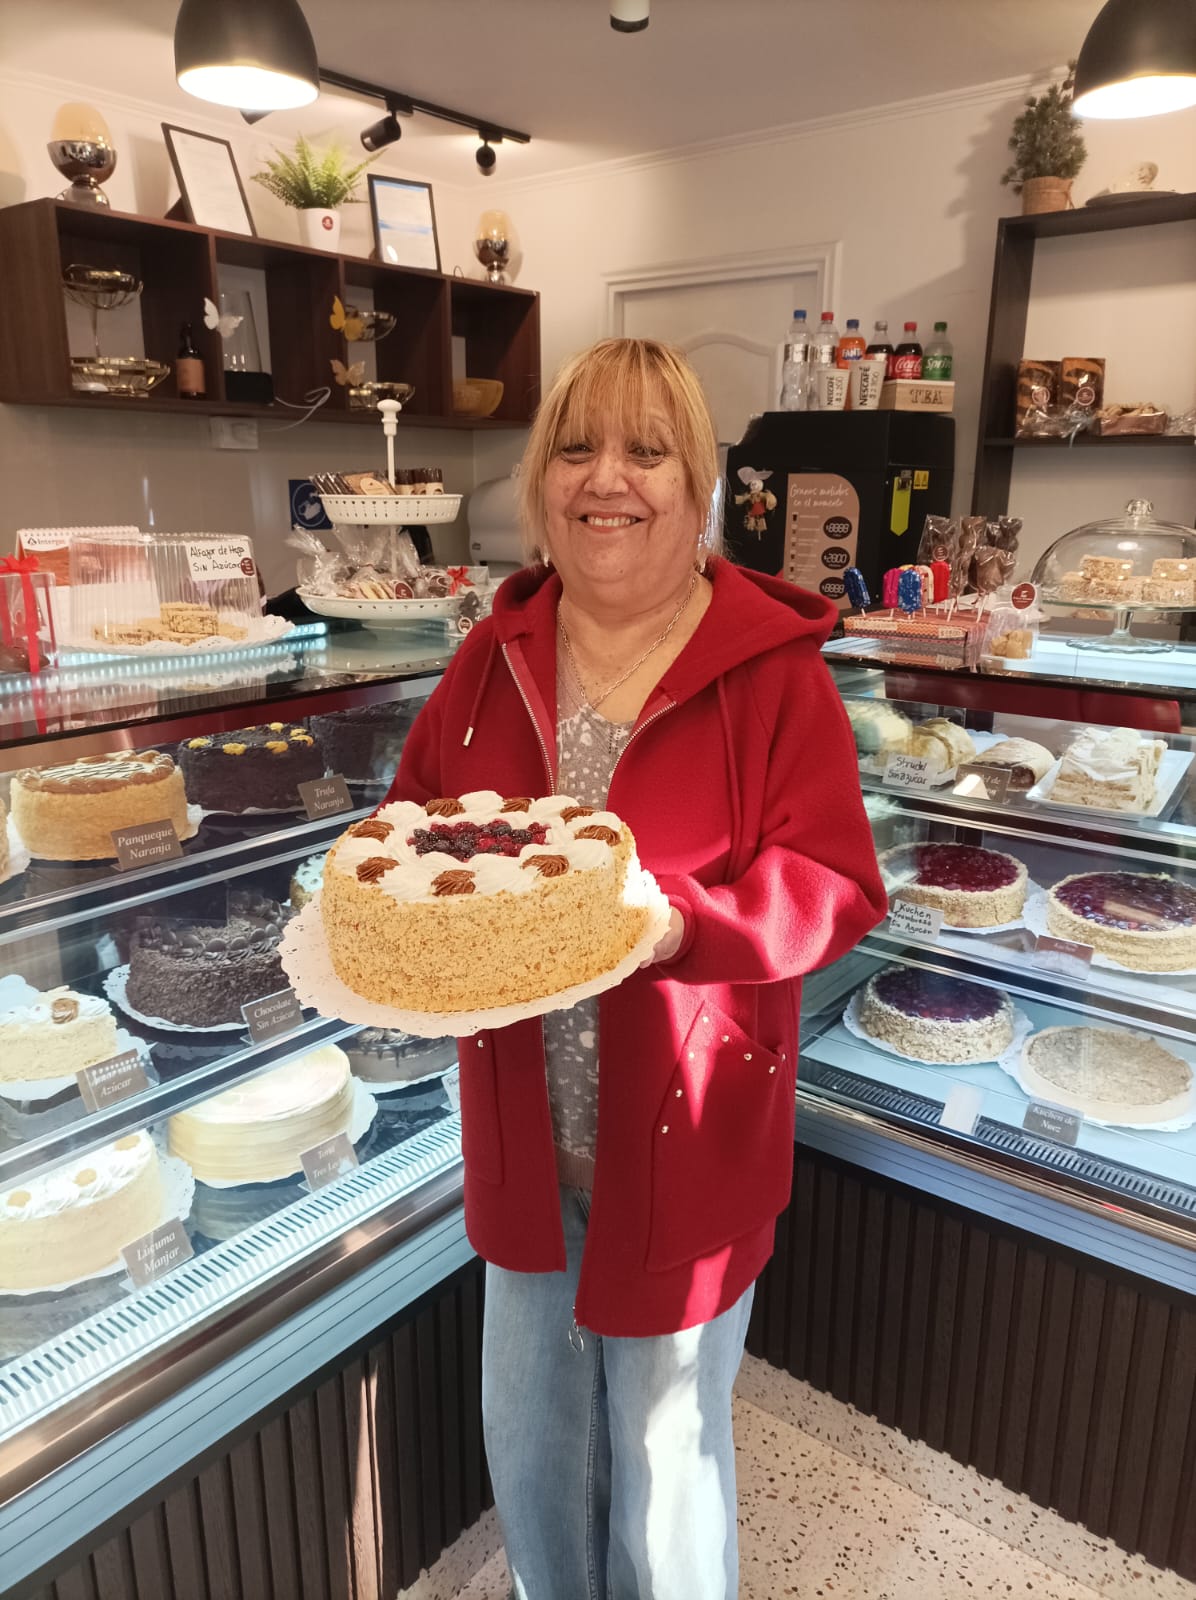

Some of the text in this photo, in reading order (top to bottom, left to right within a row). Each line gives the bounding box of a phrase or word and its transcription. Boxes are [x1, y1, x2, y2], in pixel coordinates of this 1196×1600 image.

[218, 544, 227, 555] de
[117, 828, 173, 847] Panqueque
[129, 842, 171, 860] Naranja
[900, 903, 931, 919] Kuchen
[100, 1078, 132, 1097] Azúcar
[136, 1231, 175, 1261] Lúcuma
[144, 1246, 180, 1276] Manjar
